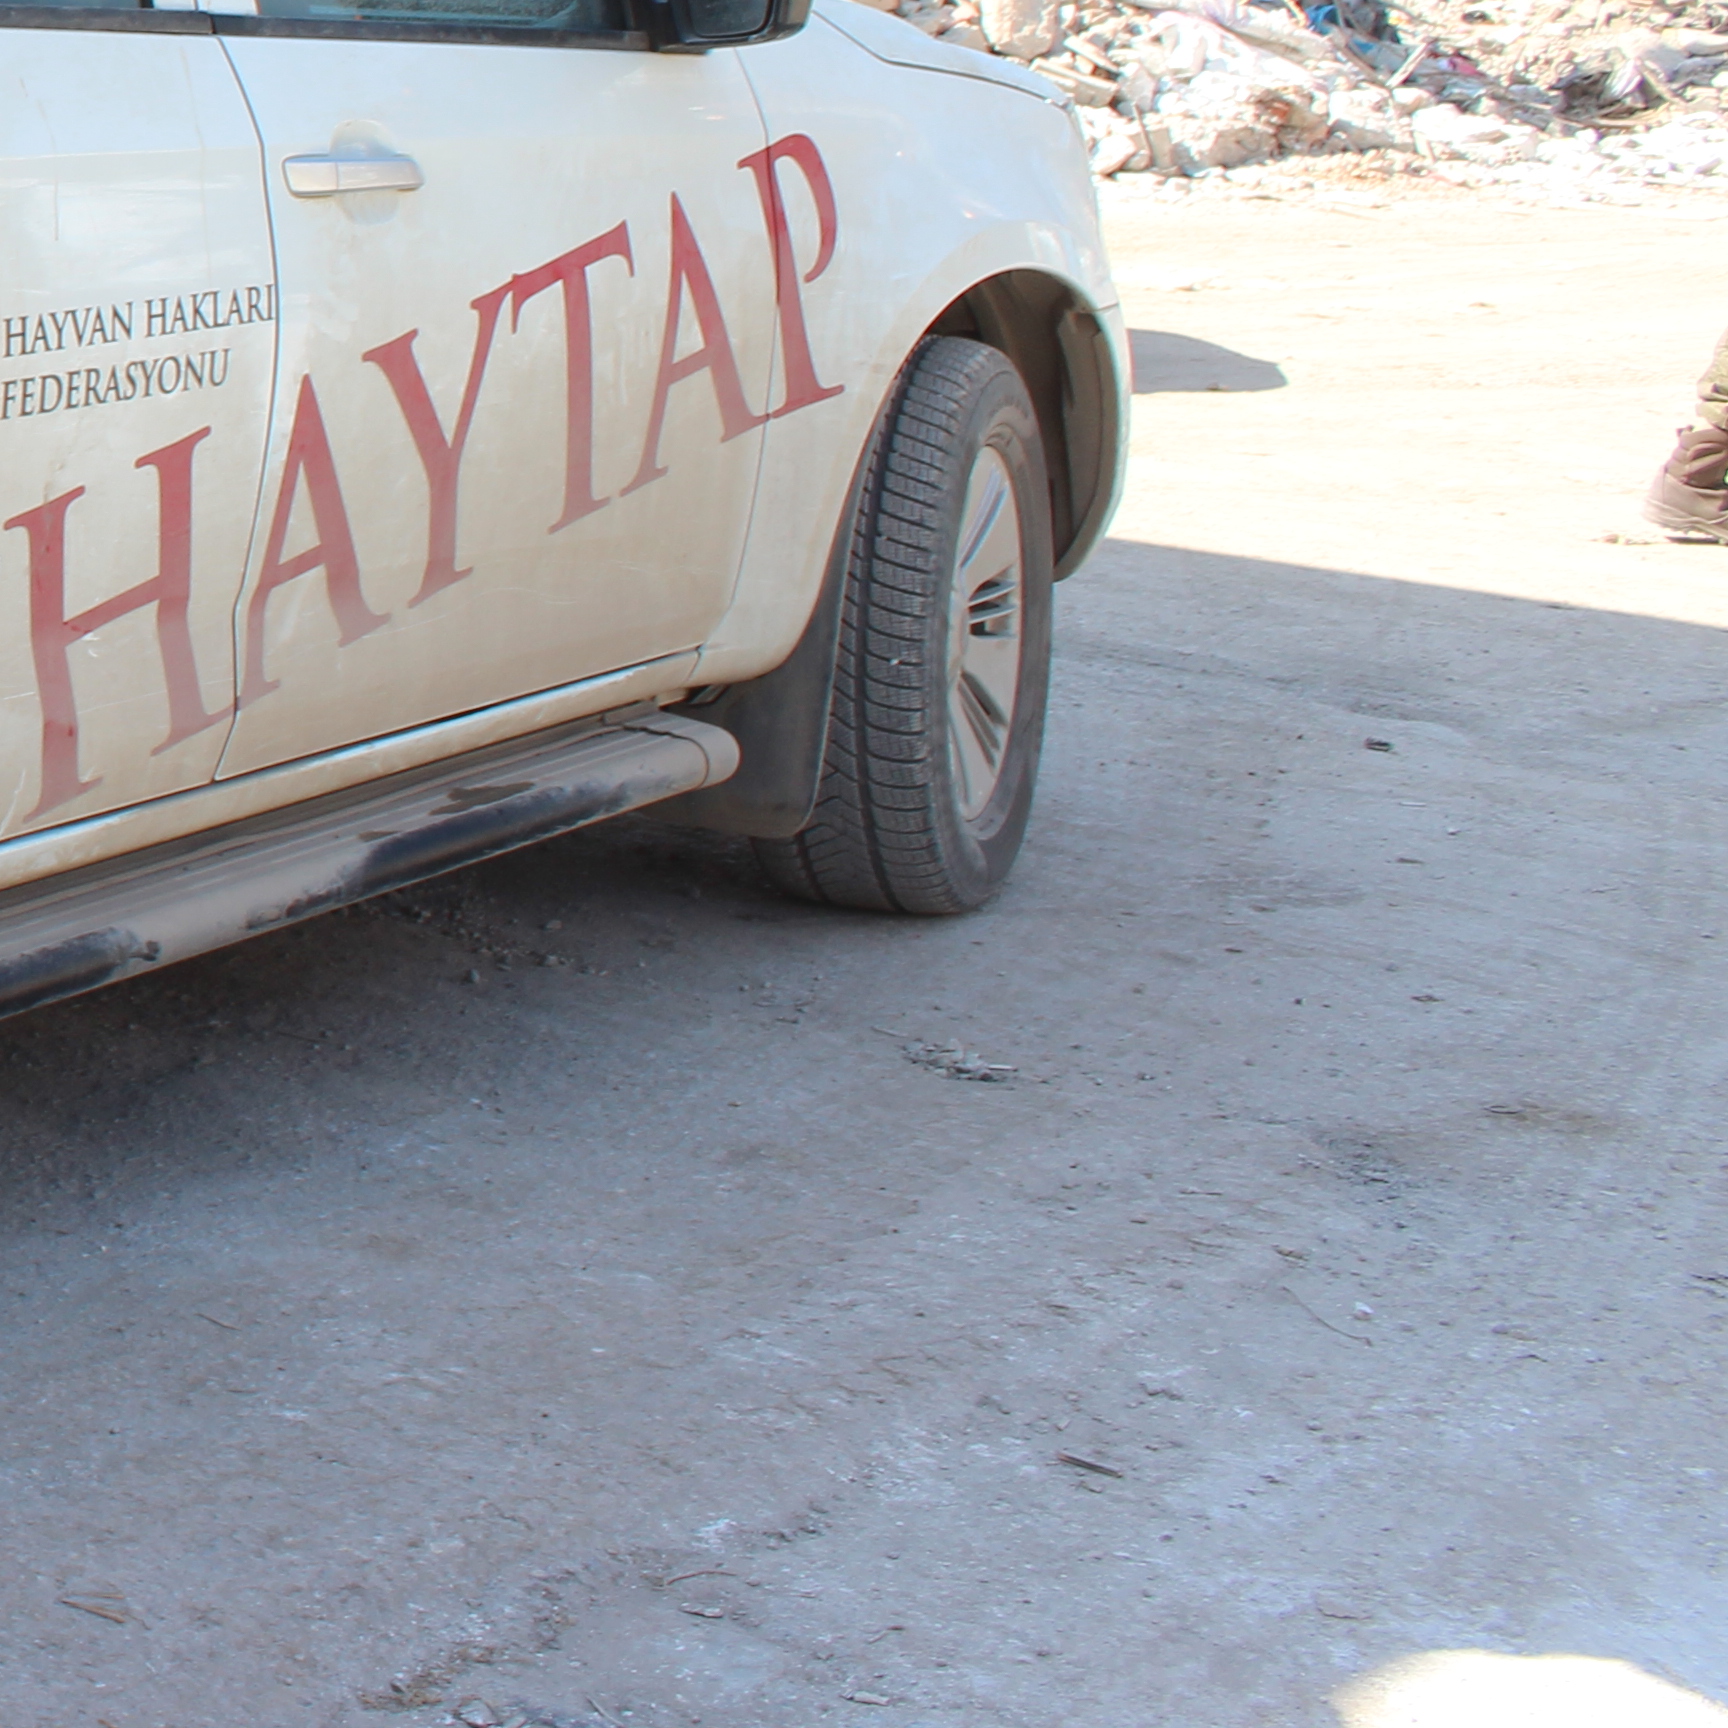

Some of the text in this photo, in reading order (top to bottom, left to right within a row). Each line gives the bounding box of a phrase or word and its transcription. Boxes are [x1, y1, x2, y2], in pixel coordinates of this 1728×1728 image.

[2, 282, 278, 359] HAYVAN HAKLARI
[0, 347, 232, 421] FEDERASYONU
[4, 132, 844, 825] HAYTAP
